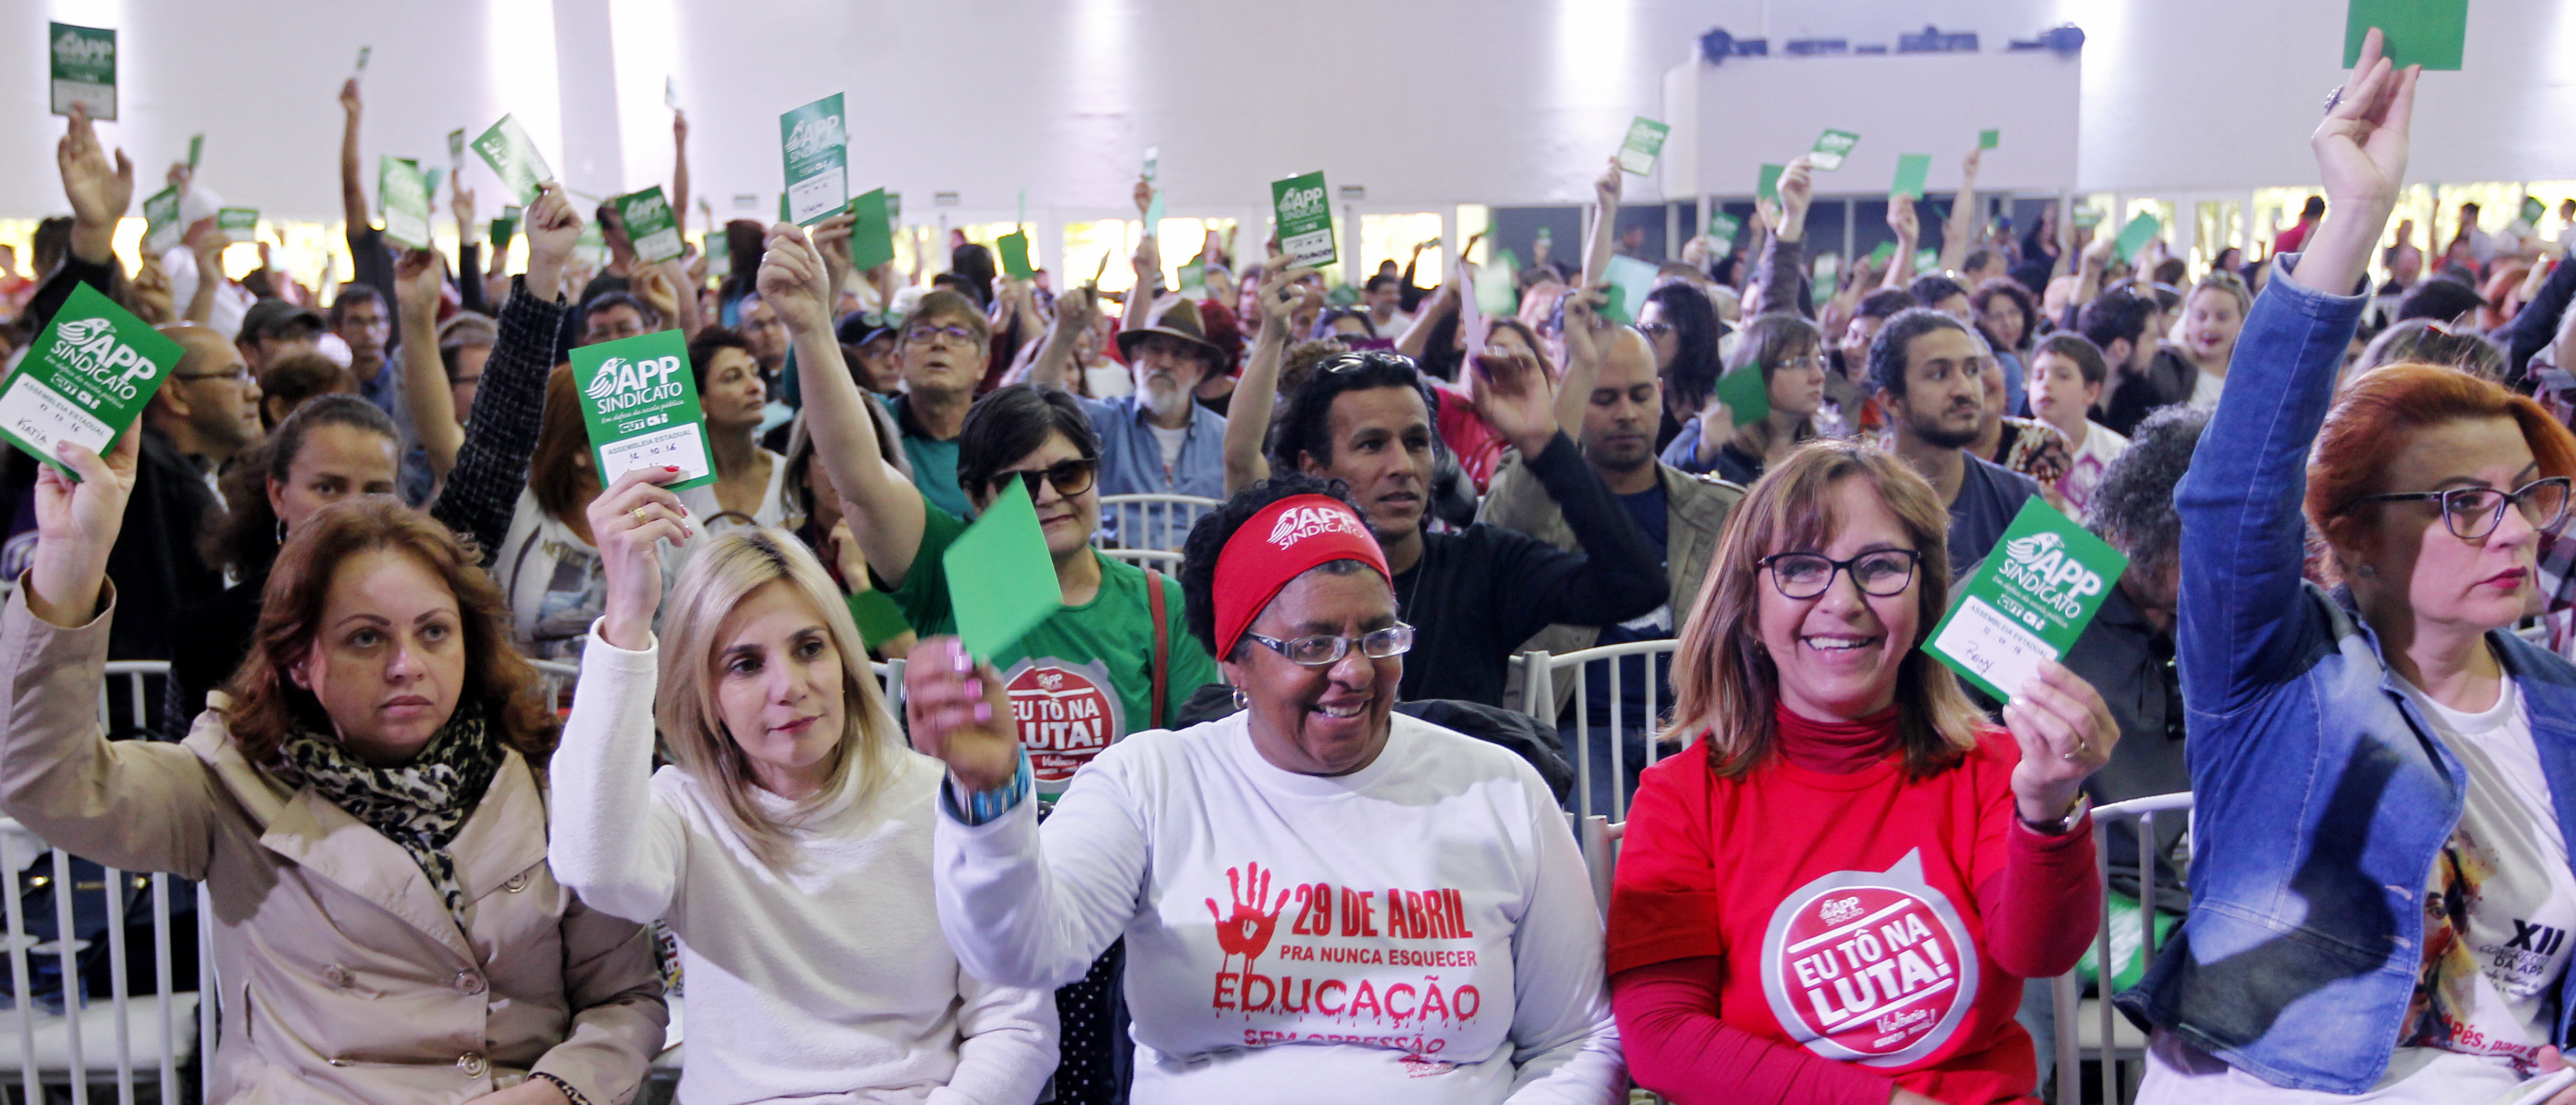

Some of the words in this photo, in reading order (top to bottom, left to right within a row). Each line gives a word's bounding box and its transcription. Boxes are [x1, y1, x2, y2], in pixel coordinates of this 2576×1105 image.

[1294, 187, 1323, 211] APP
[51, 340, 137, 400] SINDICATO
[79, 334, 157, 381] APP
[615, 356, 680, 395] APP
[23, 382, 69, 415] ASSEMBLEIA
[68, 409, 104, 436] ESTADUAL
[597, 382, 682, 414] SINDICATO
[608, 438, 655, 455] ASSEMBLEIA
[655, 429, 692, 443] ESTADUAL
[1279, 523, 1364, 551] SINDICATO
[1297, 508, 1356, 530] APP
[1998, 559, 2081, 618] SINDICATO
[2027, 549, 2101, 600] APP
[1969, 605, 2013, 638] ASSEMBLEIA
[2012, 632, 2047, 657] ESTADUAL
[1010, 701, 1033, 720] EU
[1038, 698, 1064, 720] TÔ
[1068, 697, 1101, 719] NA
[1020, 718, 1103, 749] UTA!
[1293, 883, 1331, 937] 29
[1341, 886, 1378, 937] DE
[1388, 888, 1473, 939] ABRIL
[1832, 896, 1860, 915] APP
[1280, 945, 1314, 961] PRA
[1321, 947, 1382, 964] NUNCA
[1389, 950, 1477, 967] ESQUECER
[1793, 949, 1839, 988] EU
[1836, 929, 1882, 969] TÔ
[1880, 913, 1931, 952] NA
[2504, 919, 2565, 956] XII
[1807, 938, 1952, 1026] LUTA!
[2494, 956, 2515, 970] DA
[1213, 971, 1480, 1029] EDUCAÇÃO
